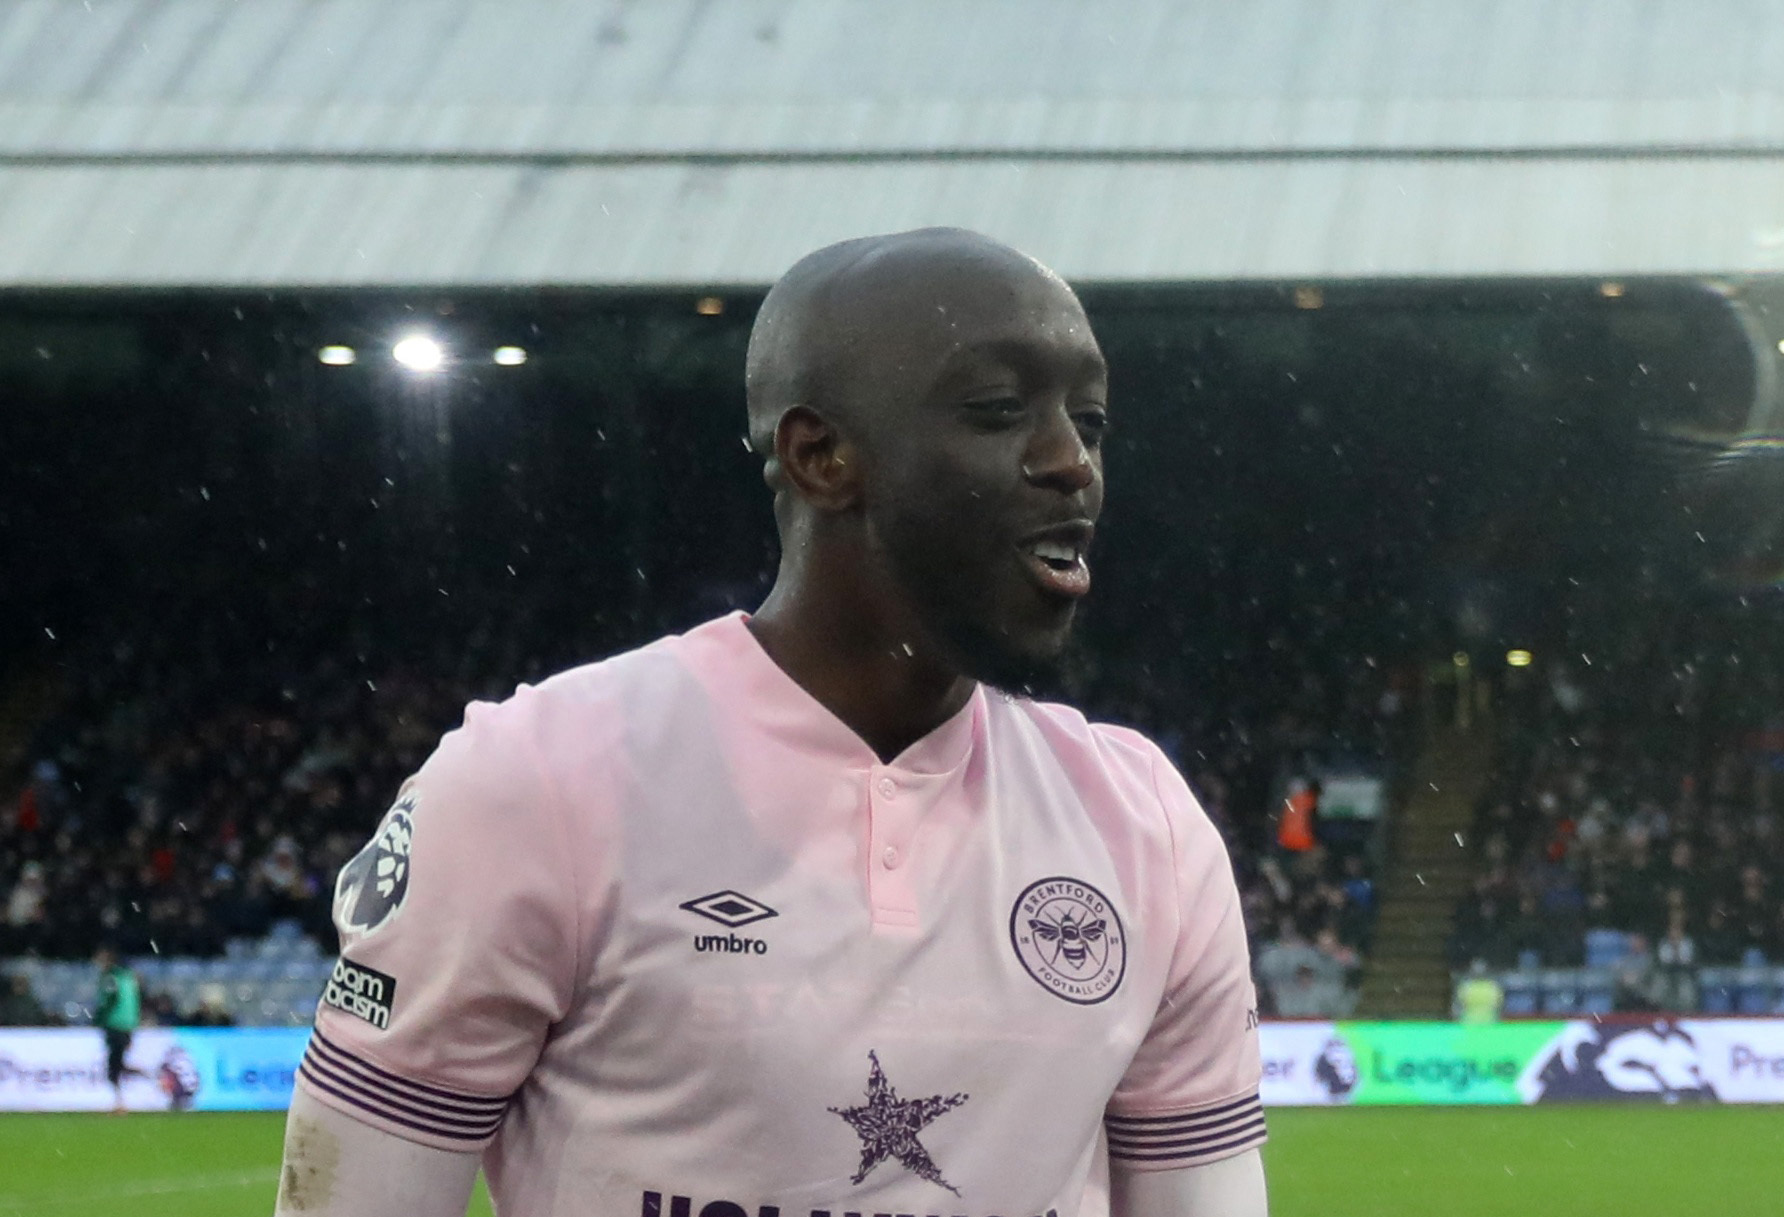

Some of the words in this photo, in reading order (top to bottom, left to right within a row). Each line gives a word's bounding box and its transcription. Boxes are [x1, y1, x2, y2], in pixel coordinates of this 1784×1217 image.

[1023, 883, 1105, 915] BRENTFORD
[694, 932, 768, 955] umbro
[332, 959, 384, 1001] oom
[1038, 967, 1094, 996] FOOTBALL
[325, 981, 389, 1030] acism
[1372, 1047, 1518, 1092] League
